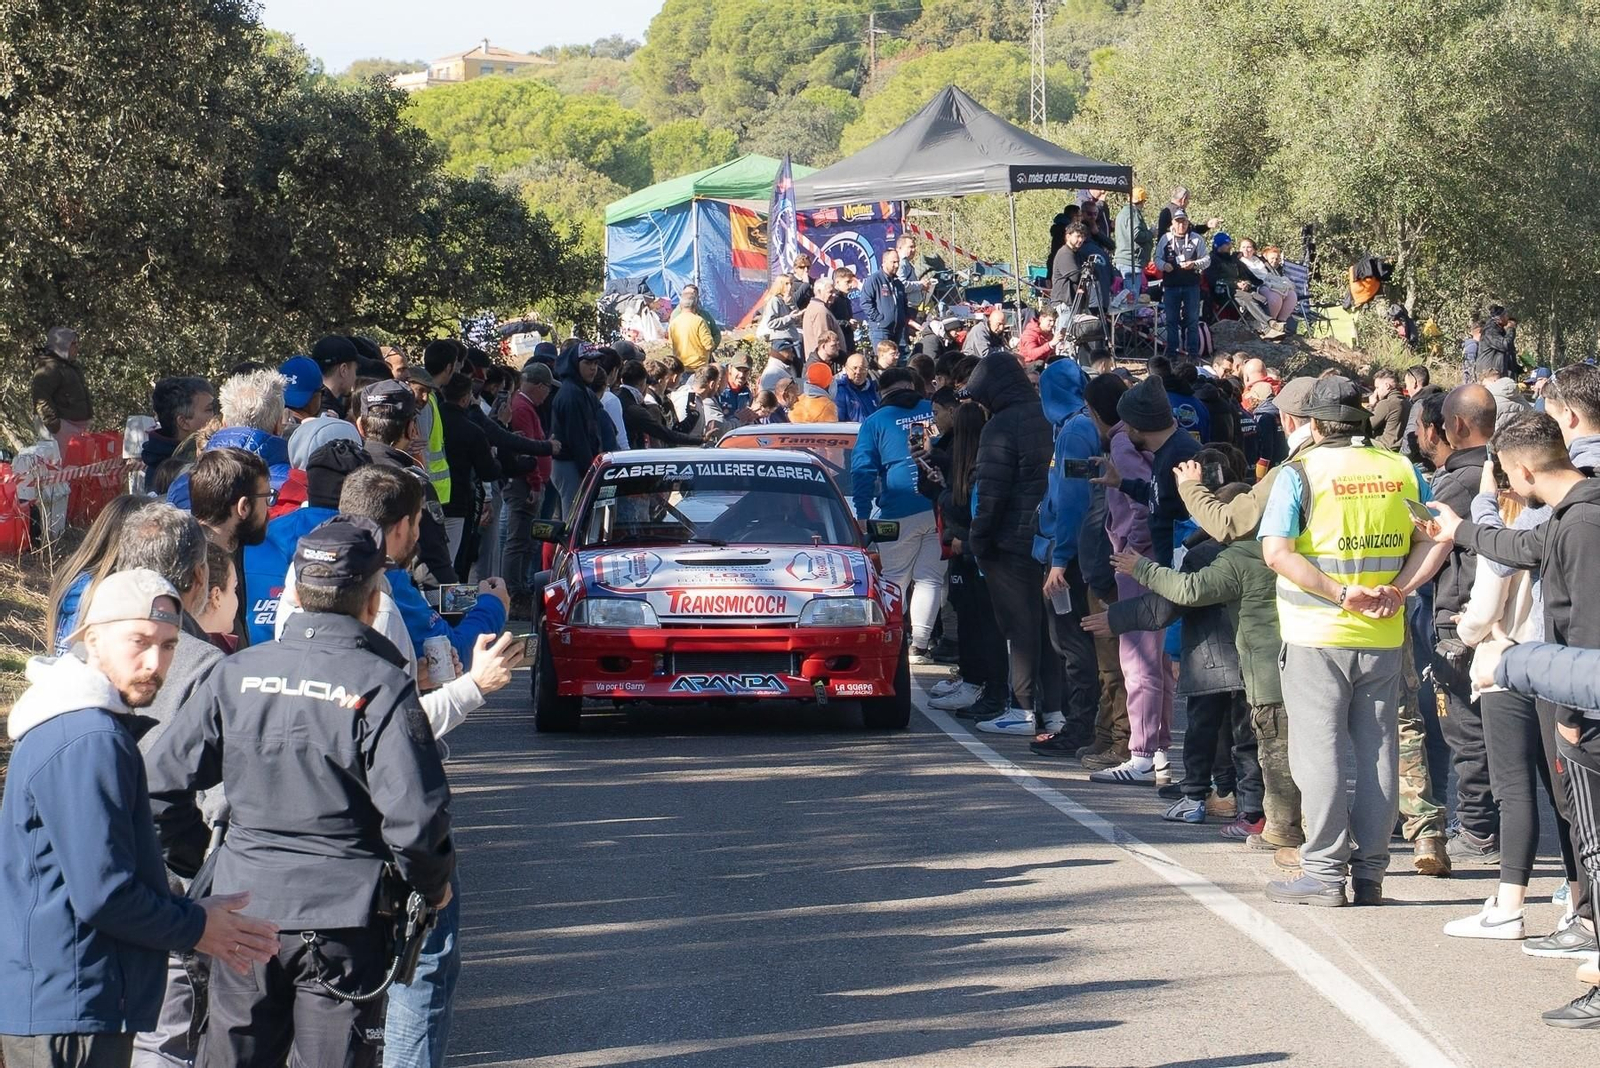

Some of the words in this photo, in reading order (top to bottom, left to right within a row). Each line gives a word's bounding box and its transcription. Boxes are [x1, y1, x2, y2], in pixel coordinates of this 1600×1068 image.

[1044, 173, 1058, 184] QUE
[1058, 173, 1088, 183] RALLYES
[778, 436, 850, 447] Tamega
[603, 464, 694, 480] CABRERA
[696, 463, 755, 476] TALLERES
[757, 464, 826, 483] CABRERA
[1336, 474, 1377, 482] azulejos
[1331, 478, 1404, 496] bernier
[1338, 529, 1404, 551] ORGANIZACIÓN
[666, 590, 787, 614] TRANSMICOCH
[240, 676, 348, 701] POLICIA
[596, 682, 605, 690] Va
[605, 683, 617, 692] por
[625, 682, 645, 692] Garry
[669, 675, 789, 694] ARANDA
[835, 683, 846, 691] LA
